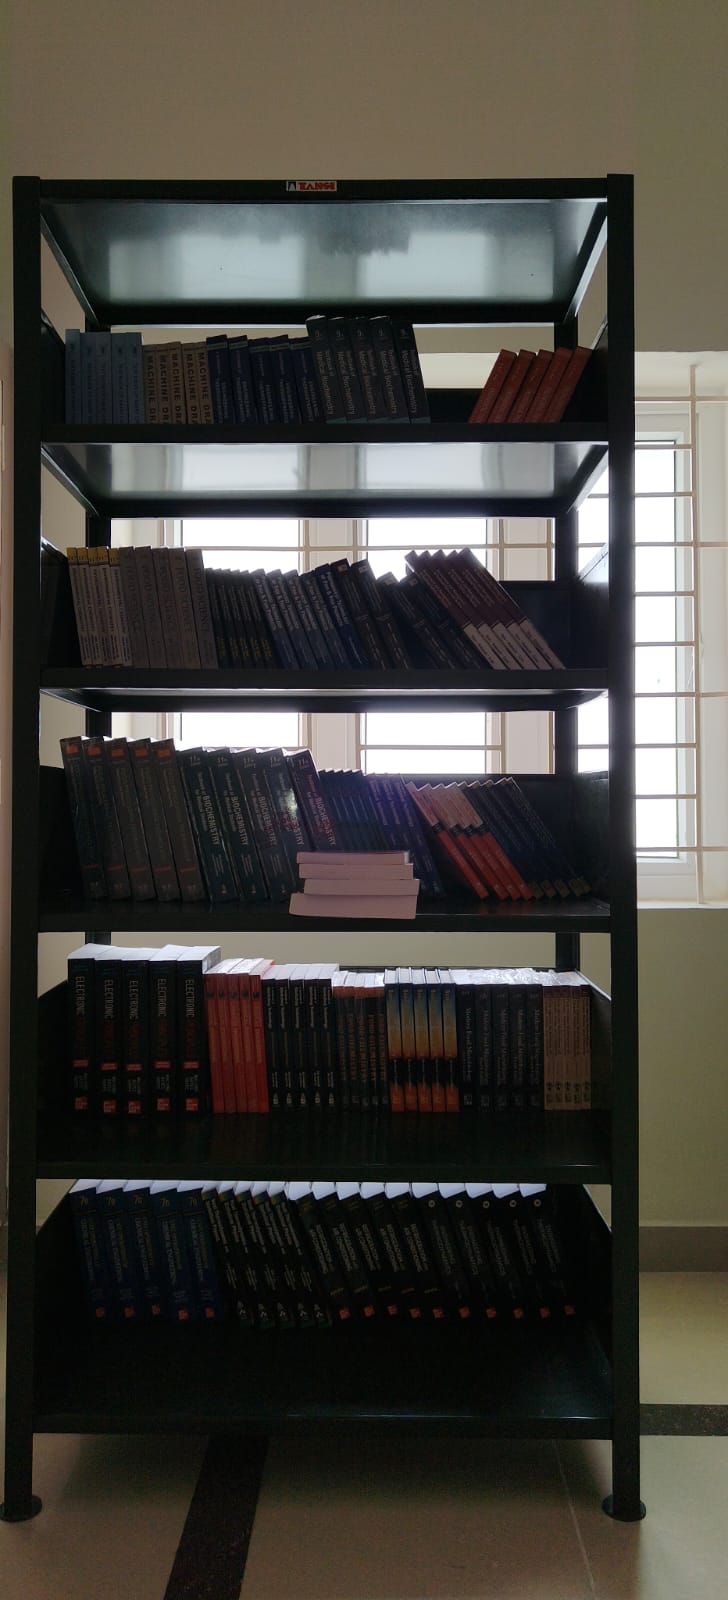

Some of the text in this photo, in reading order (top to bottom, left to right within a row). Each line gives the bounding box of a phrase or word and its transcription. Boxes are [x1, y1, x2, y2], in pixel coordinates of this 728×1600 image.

[148, 355, 156, 402] MACHINE
[160, 355, 168, 402] MACHINE
[172, 354, 181, 400] MACHINE
[187, 354, 197, 400] MACHINE
[198, 352, 209, 400] MACHINE
[204, 796, 220, 846] BIOCHEMISTRY
[232, 796, 249, 846] BIOCHEMISTRY
[104, 980, 114, 1020] ELECTRONIC
[158, 978, 168, 1016] ELECTRONIC
[186, 980, 196, 1018] ELECTRONIC
